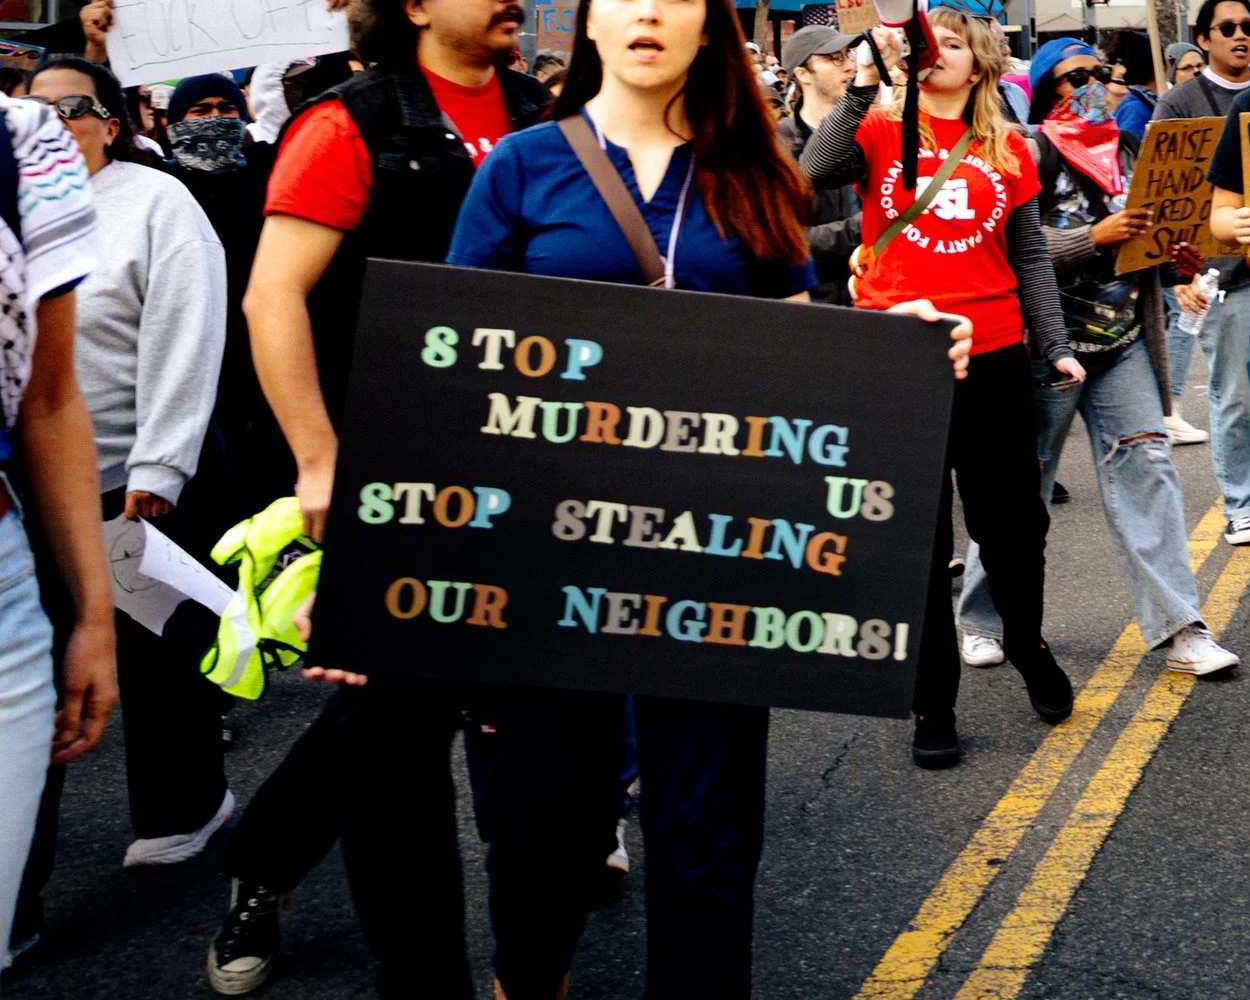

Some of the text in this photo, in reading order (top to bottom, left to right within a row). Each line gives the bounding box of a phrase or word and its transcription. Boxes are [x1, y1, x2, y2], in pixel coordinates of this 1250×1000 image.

[938, 148, 949, 160] &
[933, 230, 983, 254] PARTY
[420, 325, 604, 381] STOP
[480, 392, 850, 467] MURDERING
[823, 475, 895, 522] US
[357, 481, 848, 577] STOP STEALING
[384, 576, 909, 662] OUR NEIGHBORS!
